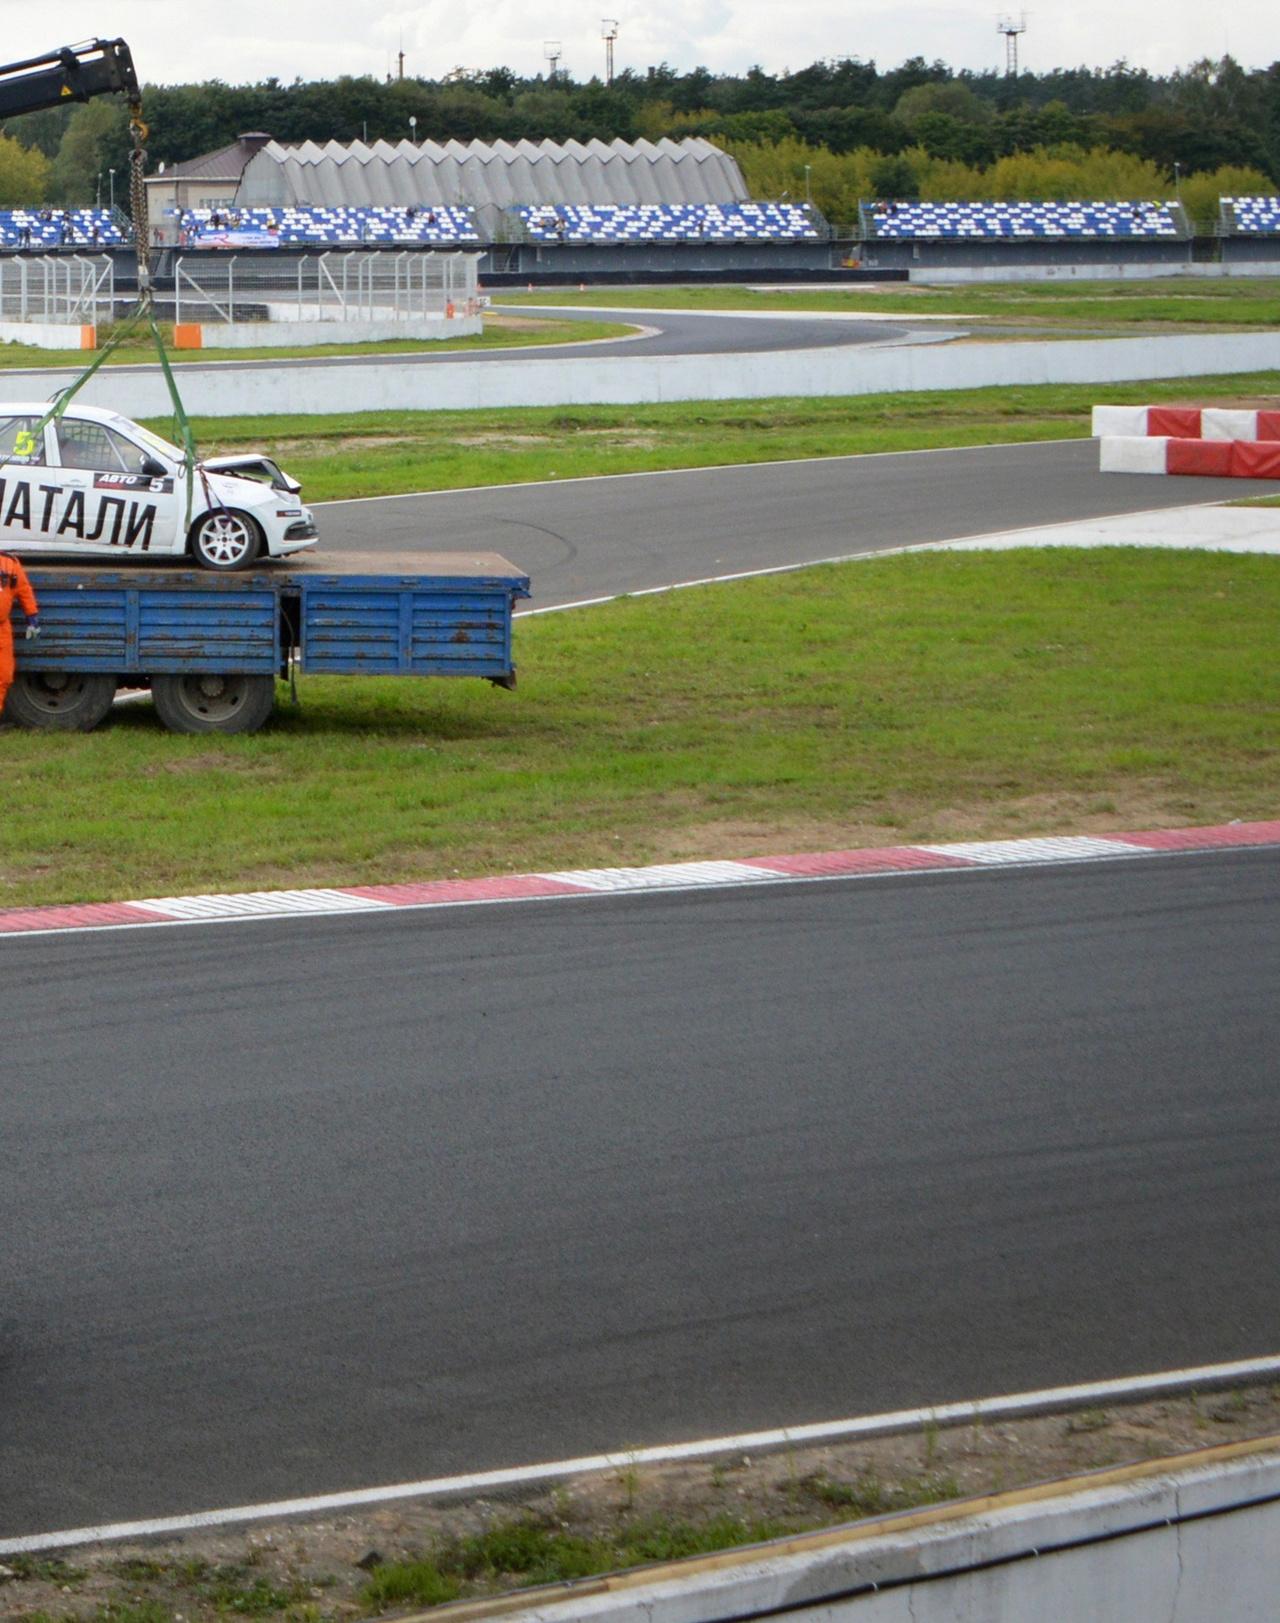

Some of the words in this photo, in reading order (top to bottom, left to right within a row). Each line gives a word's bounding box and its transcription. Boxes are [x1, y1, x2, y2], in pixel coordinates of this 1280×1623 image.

[13, 431, 35, 456] 5
[99, 473, 137, 485] АВТО
[148, 477, 165, 493] 5
